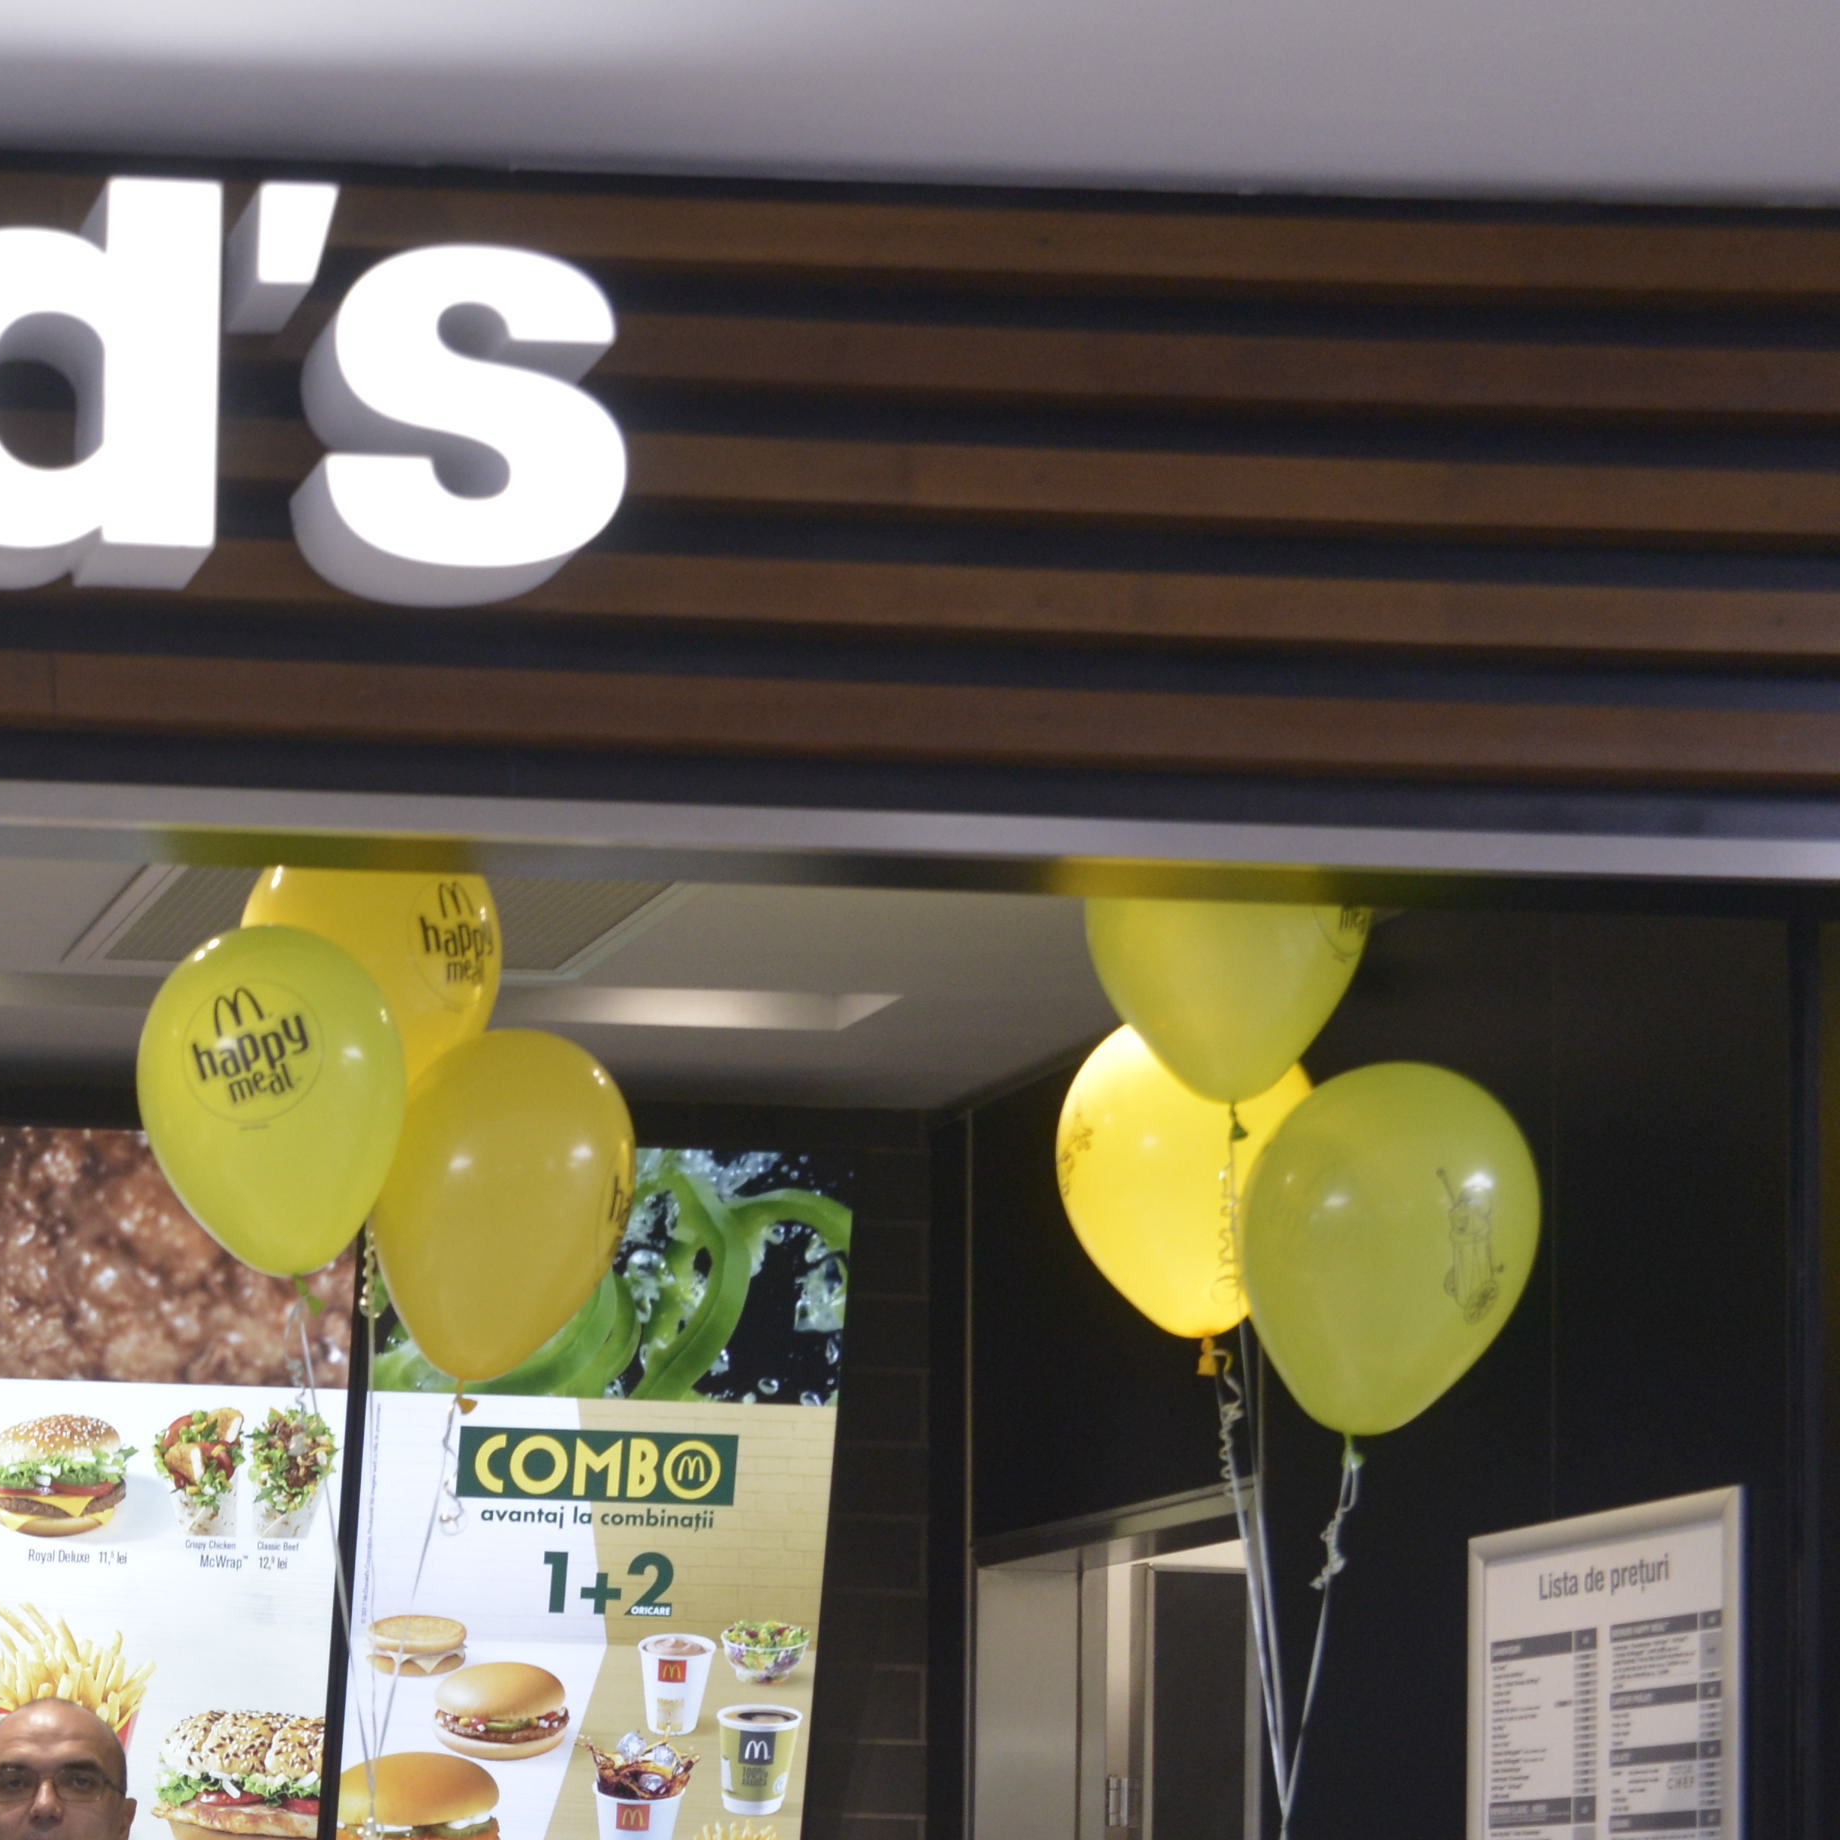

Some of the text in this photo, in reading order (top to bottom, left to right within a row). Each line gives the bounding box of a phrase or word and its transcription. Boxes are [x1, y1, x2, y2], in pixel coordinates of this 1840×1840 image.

[192, 1014, 310, 1082] happy
[474, 1433, 722, 1500] COMBO
[480, 1506, 566, 1529] avantaj
[573, 1507, 592, 1526] la
[185, 1540, 236, 1550] Crispy Chicken
[257, 1542, 299, 1551] Classic Beef
[28, 1548, 127, 1564] Royal Deluxe lei
[276, 1557, 288, 1569] lei
[1538, 1571, 1578, 1601] Lista
[1584, 1565, 1605, 1591] de
[630, 1604, 672, 1618] ORICARE
